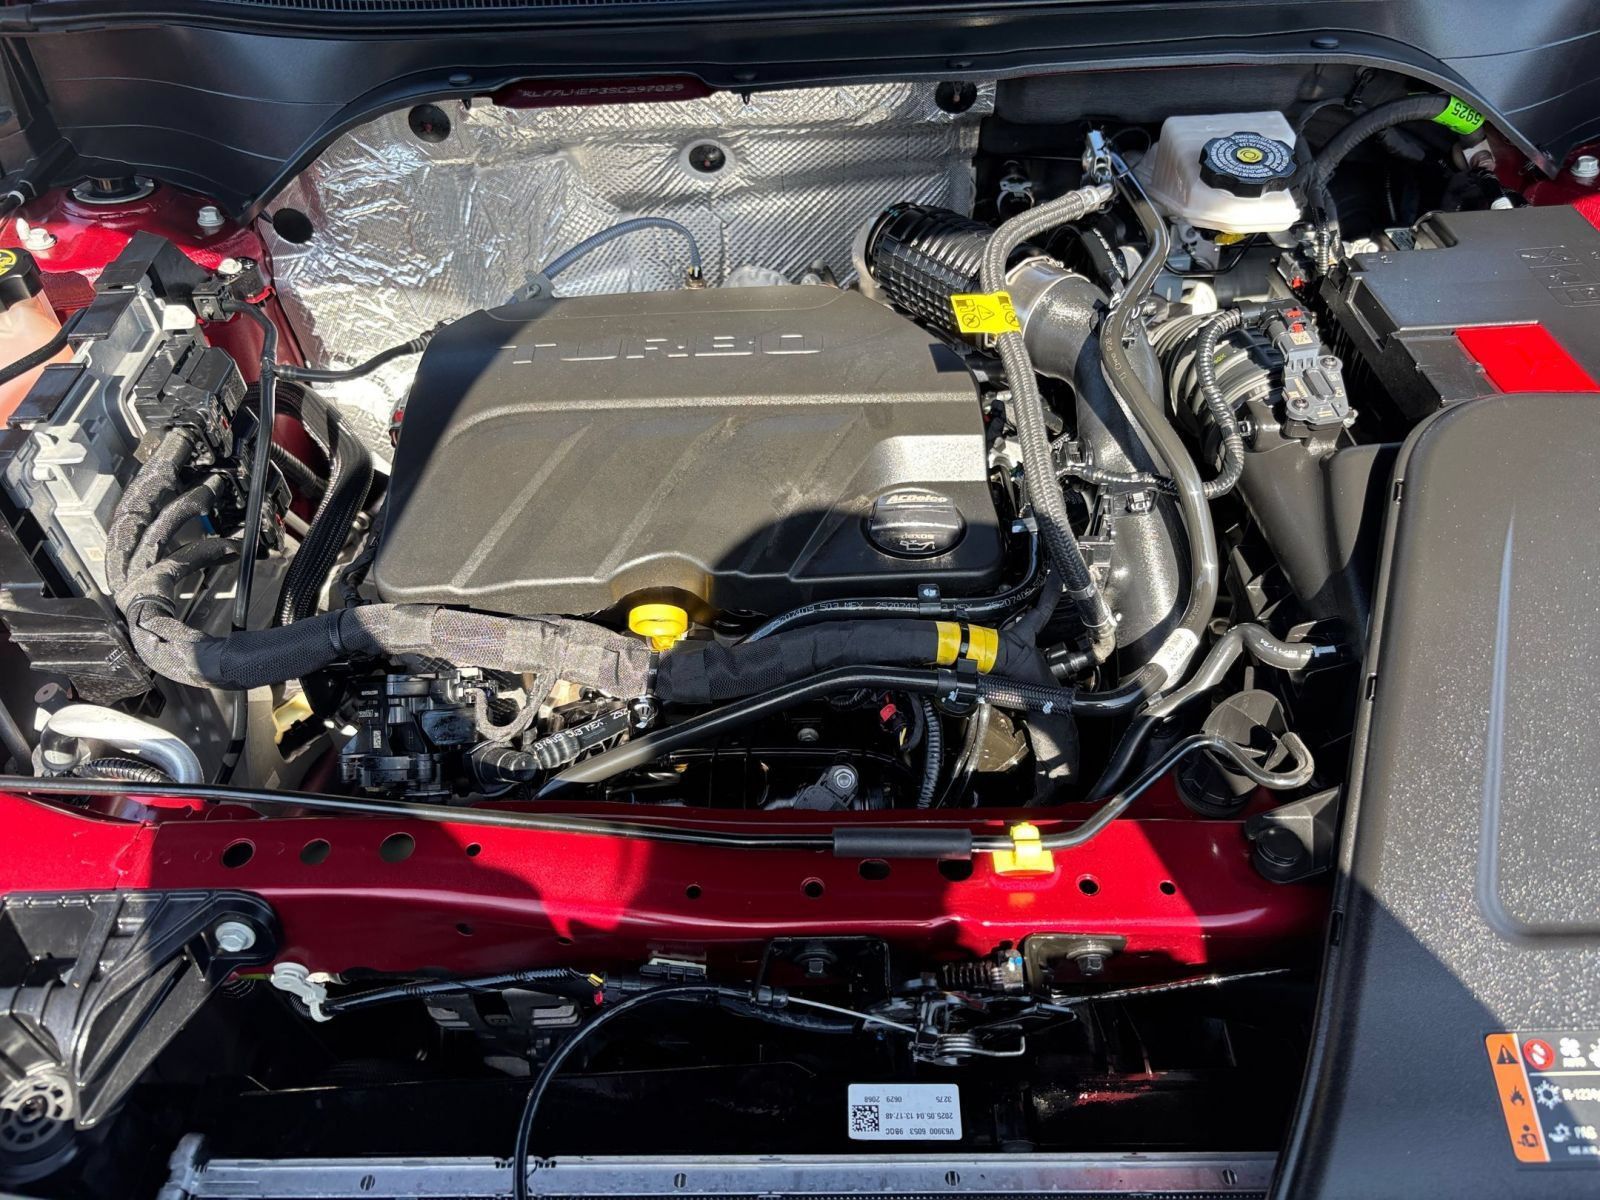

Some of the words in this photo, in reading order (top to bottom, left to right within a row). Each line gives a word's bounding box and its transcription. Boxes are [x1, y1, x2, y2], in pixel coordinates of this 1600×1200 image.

[1451, 102, 1482, 125] 5925
[498, 334, 824, 364] TURBO
[886, 494, 948, 504] ACDelco
